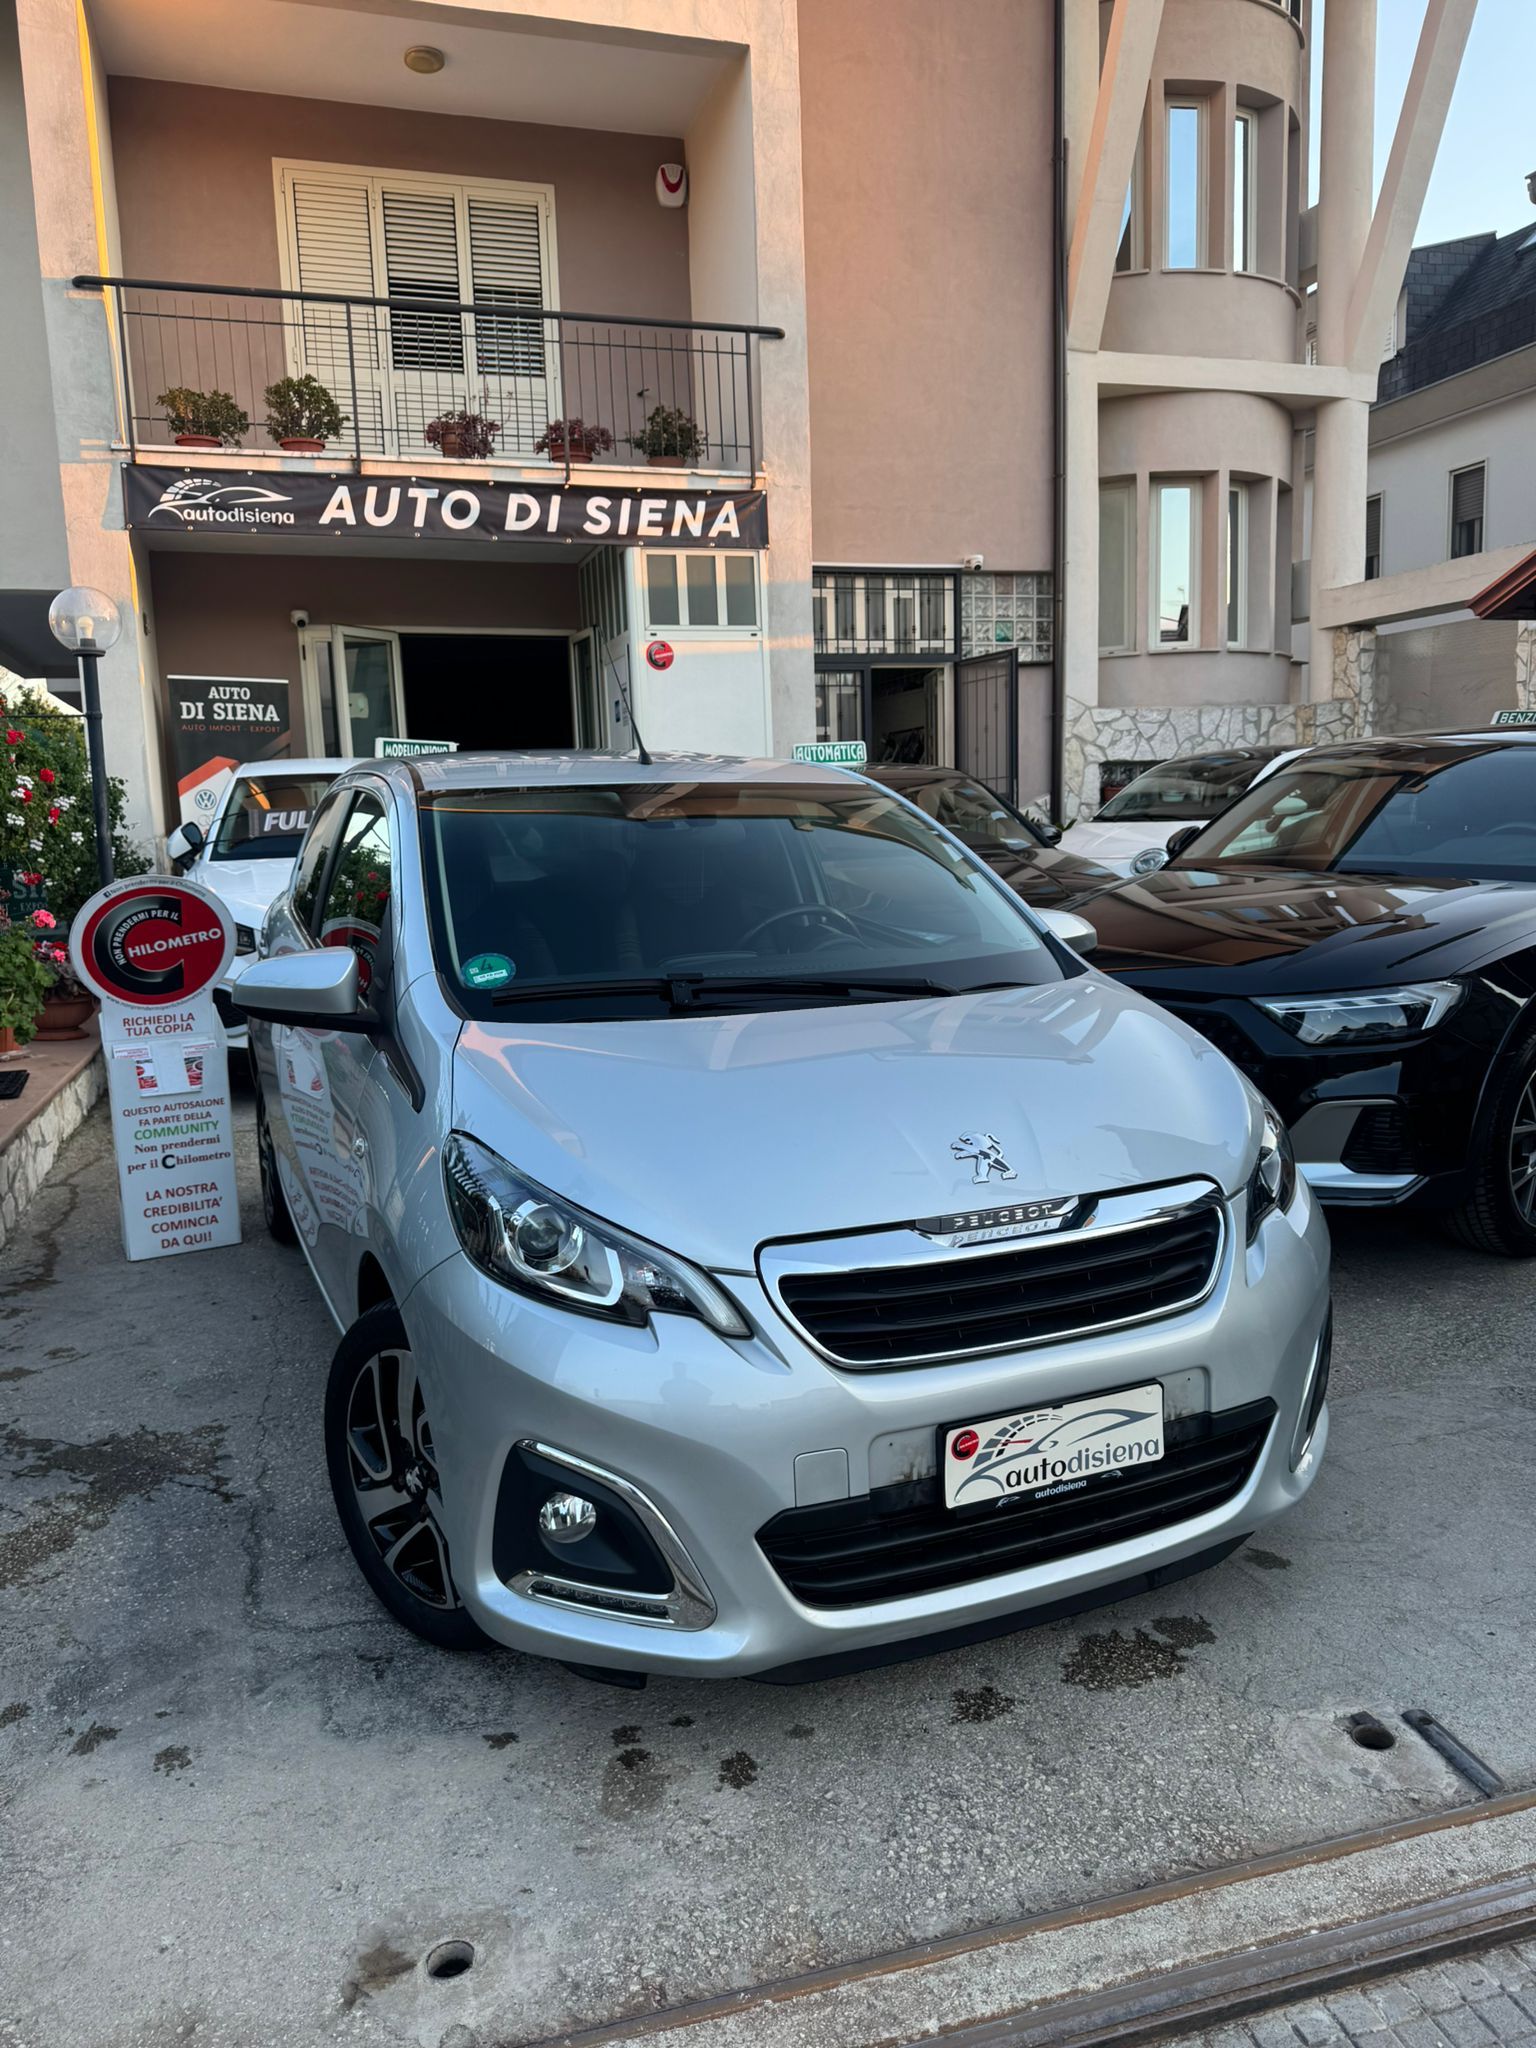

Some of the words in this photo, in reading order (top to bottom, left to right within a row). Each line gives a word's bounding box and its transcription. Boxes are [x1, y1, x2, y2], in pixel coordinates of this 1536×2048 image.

[183, 506, 295, 525] autodisiena
[318, 485, 481, 530] AUTO
[504, 492, 561, 533] DI
[582, 496, 741, 538] SIENA
[208, 686, 251, 700] AUTO
[180, 701, 205, 719] DI
[213, 702, 280, 722] SIENA
[182, 723, 206, 732] AUTO
[209, 724, 241, 732] IMPORT
[250, 725, 280, 733] EXPORT
[384, 743, 420, 757] MODELLO
[796, 744, 864, 761] AUTOMATICA
[263, 810, 316, 832] FUL
[151, 910, 169, 918] PER
[170, 911, 179, 920] IL
[112, 911, 149, 947] PRENDERMI
[127, 928, 222, 957] HILOMETRO
[113, 948, 127, 965] NON
[480, 958, 493, 971] 4
[123, 1013, 176, 1027] RICHIEDI
[180, 1012, 195, 1022] LA
[125, 1026, 151, 1037] TUA
[155, 1023, 193, 1034] COPIA
[122, 1105, 161, 1117] QUESTO
[163, 1097, 225, 1112] AUTOSALONE
[139, 1118, 151, 1126] FA
[153, 1114, 181, 1125] PARTE
[184, 1111, 212, 1121] DELLA
[134, 1120, 219, 1140] COMMUNITY
[134, 1144, 158, 1154] Non
[161, 1134, 221, 1153] prendermi
[127, 1162, 147, 1174] per
[150, 1159, 158, 1169] il
[161, 1150, 231, 1169] Chilometro
[146, 1190, 162, 1201] LA
[165, 1182, 219, 1199] NOSTRA
[143, 1196, 223, 1218] CREDIBILITA'
[953, 1204, 1053, 1229] PEUGEOT
[151, 1214, 219, 1234] COMINCIA
[161, 1237, 180, 1249] DA
[183, 1231, 212, 1246] QUI!
[1005, 1437, 1160, 1489] autodisiena
[1034, 1479, 1087, 1499] autodisiena
